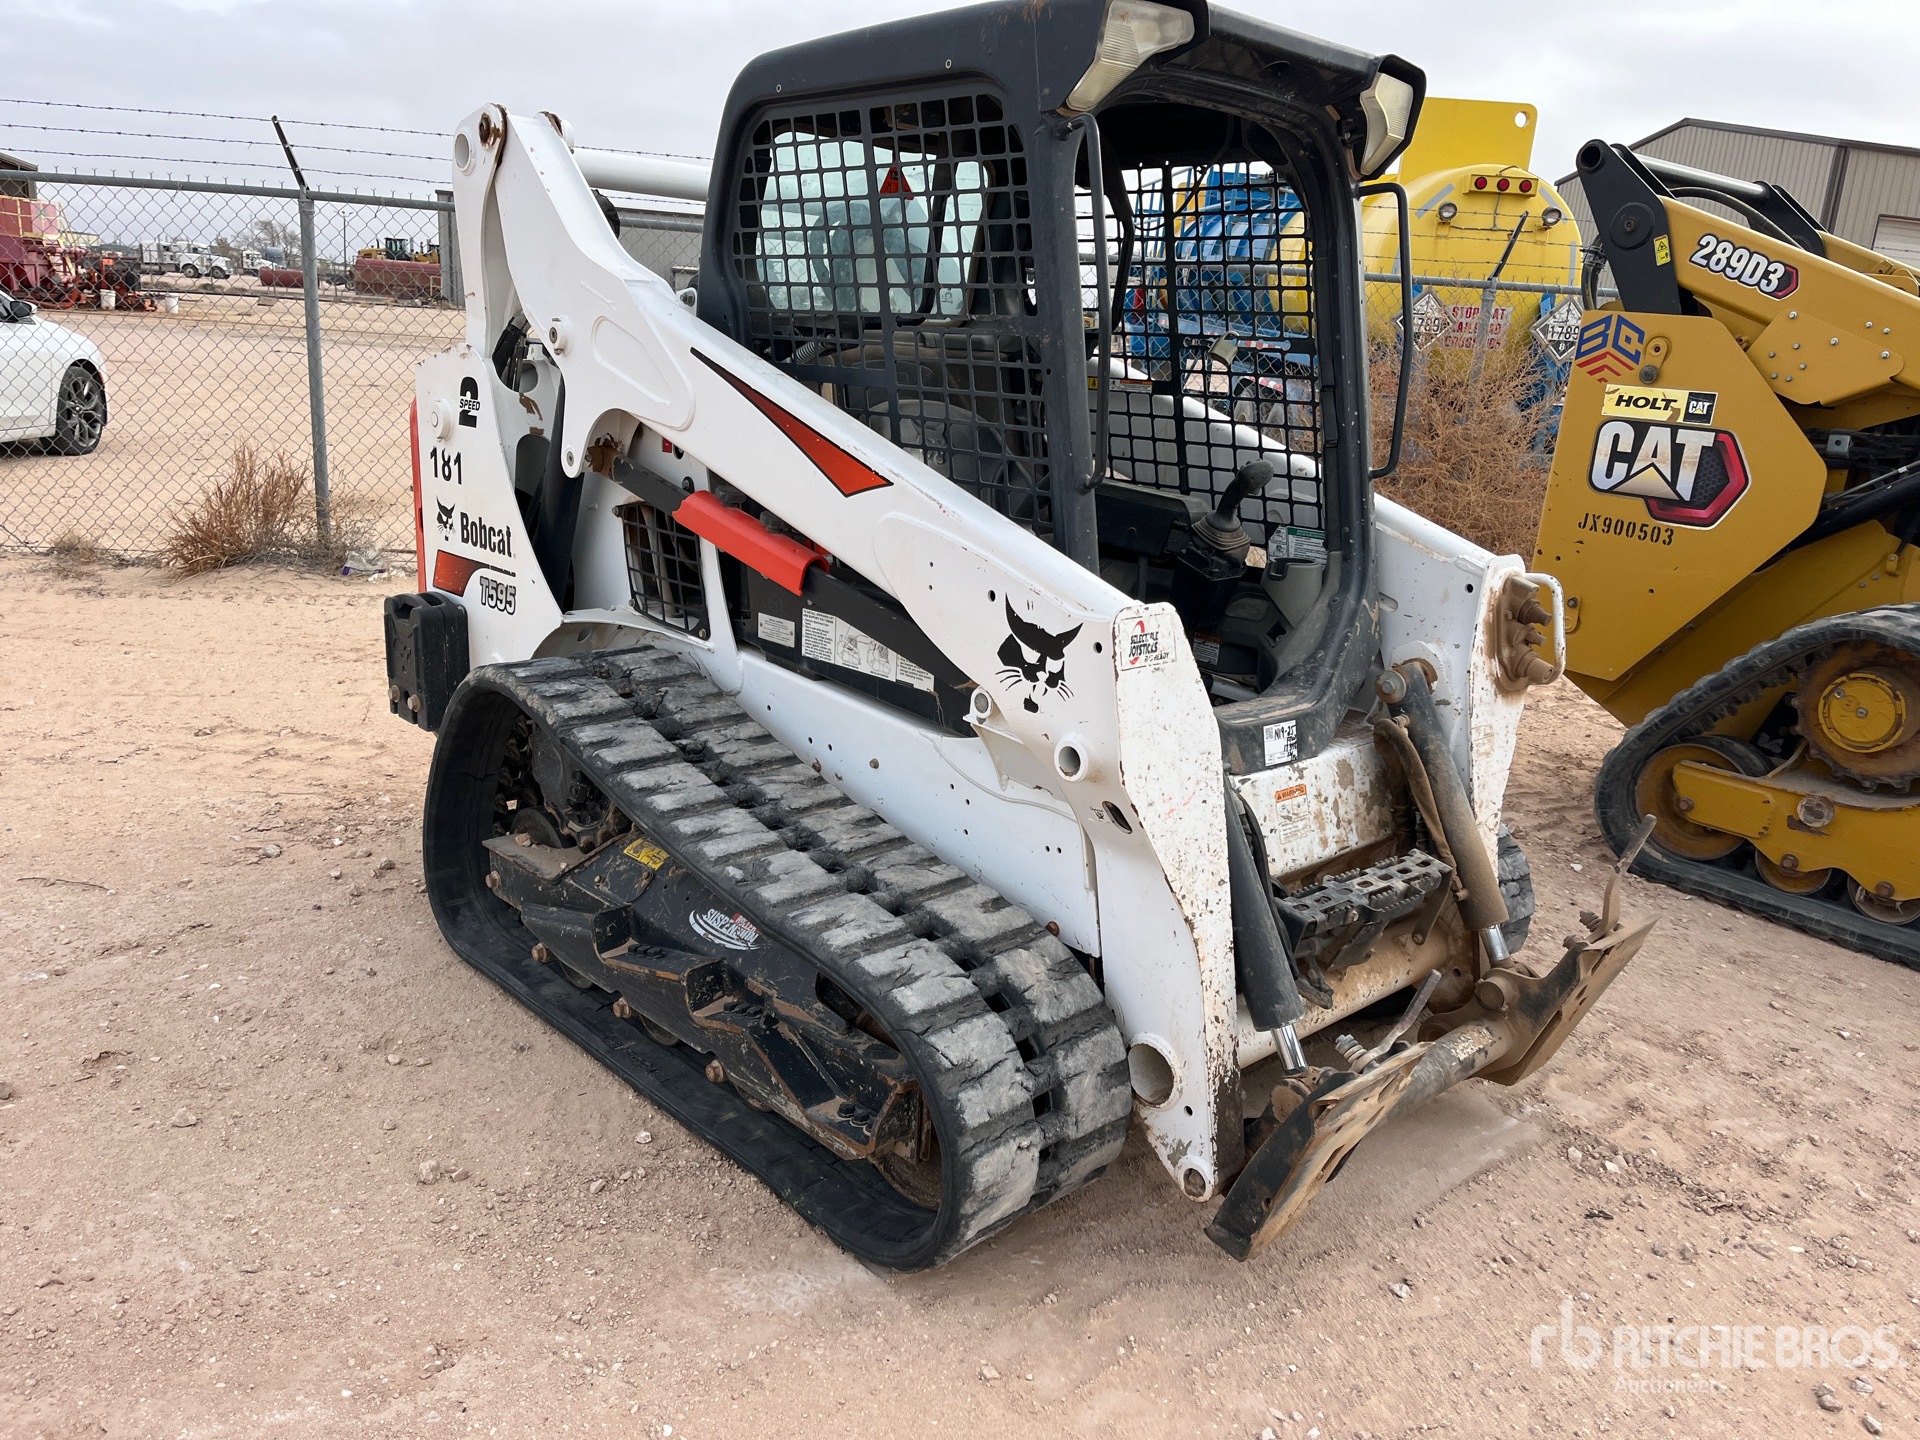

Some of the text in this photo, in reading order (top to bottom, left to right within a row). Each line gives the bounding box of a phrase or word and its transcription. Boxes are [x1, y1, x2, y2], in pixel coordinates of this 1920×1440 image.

[1690, 235, 1785, 293] 289D3
[1413, 317, 1441, 332] 789
[1452, 306, 1506, 320] STOP AT
[1550, 325, 1579, 341] 1789
[459, 398, 481, 411] SPEED
[1615, 394, 1677, 411] HOLT
[1688, 400, 1711, 415] CAT
[430, 446, 463, 485] 181
[1591, 421, 1716, 502] CAT
[460, 511, 512, 558] Bobcat
[1578, 512, 1675, 547] JX900503
[479, 575, 516, 615] T595
